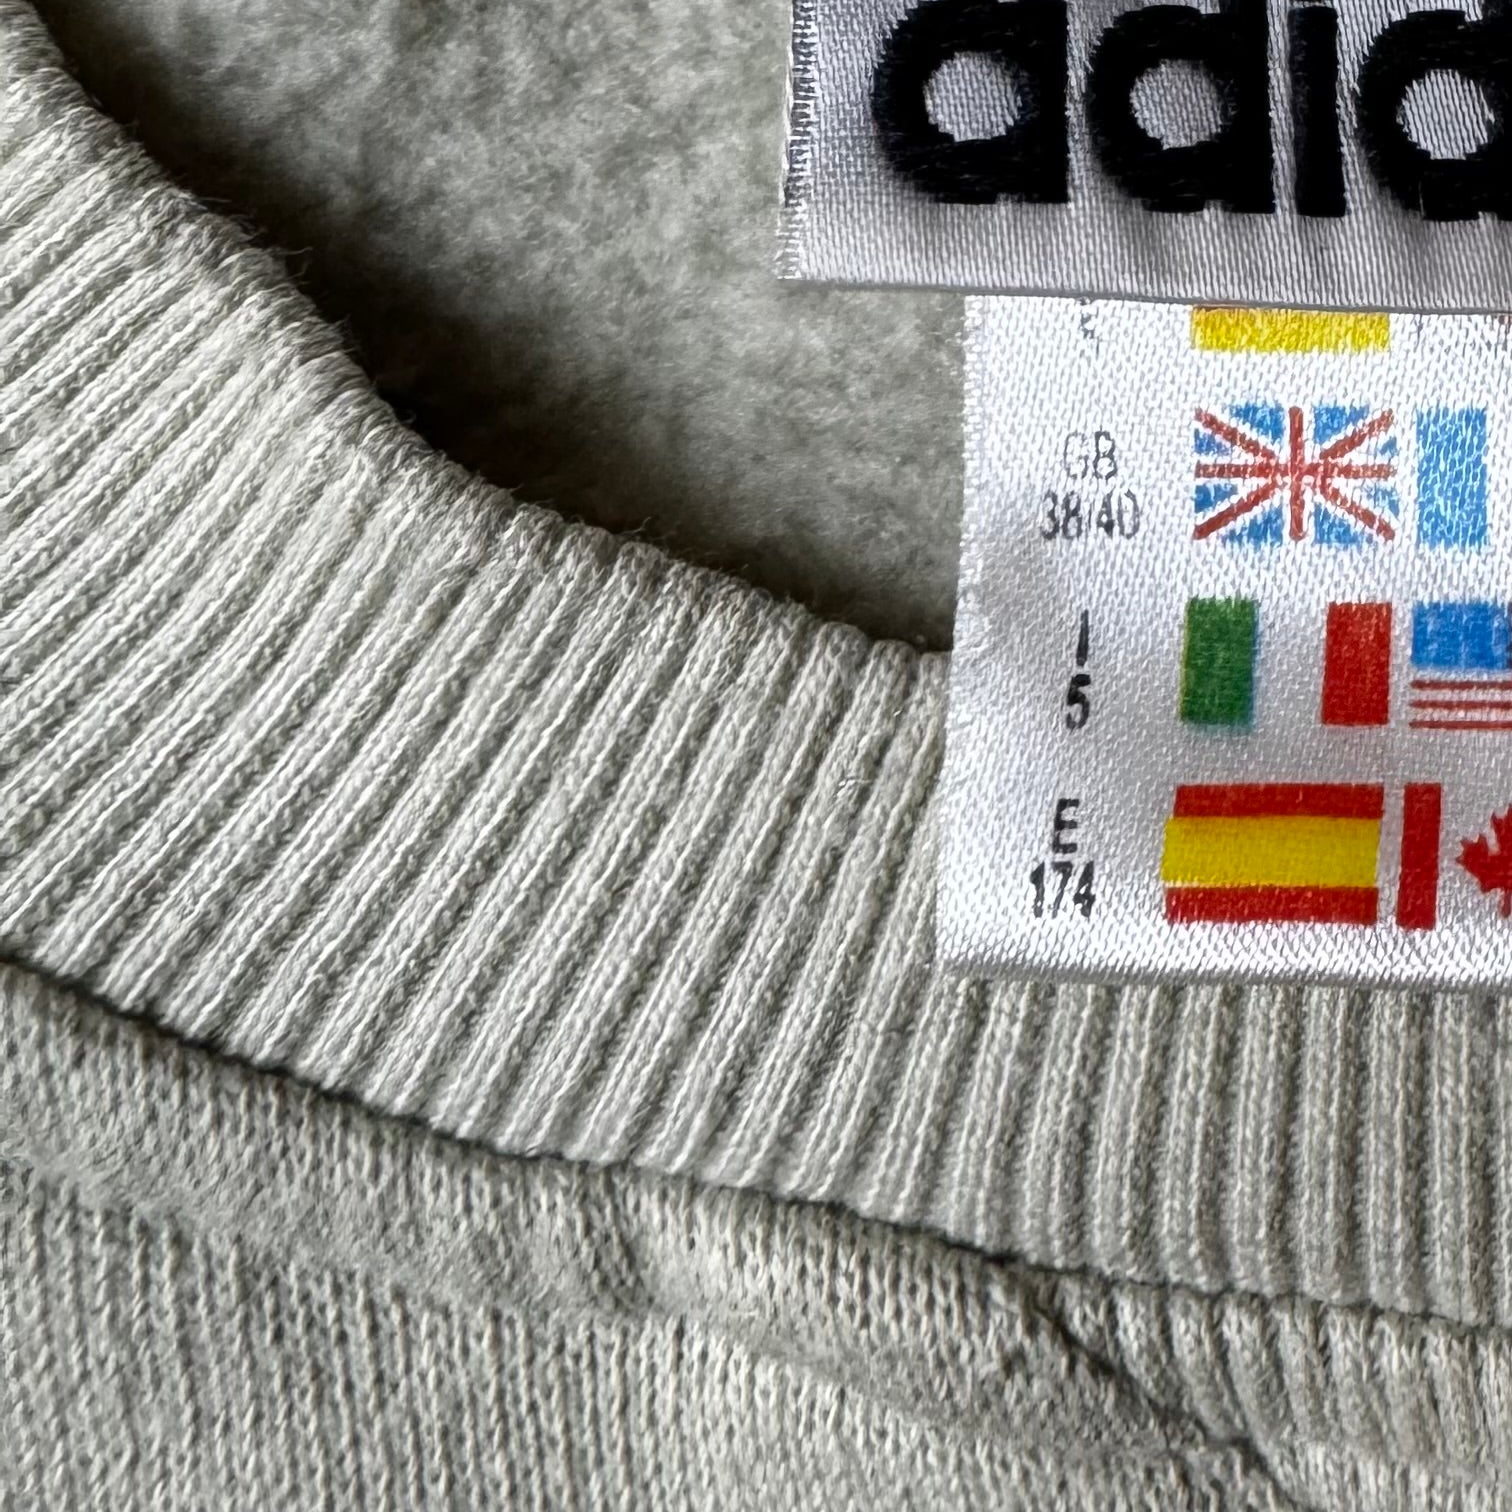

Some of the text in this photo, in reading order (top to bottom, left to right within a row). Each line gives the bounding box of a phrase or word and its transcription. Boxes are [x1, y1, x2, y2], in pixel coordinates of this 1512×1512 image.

[1063, 430, 1118, 480] GB
[1065, 673, 1092, 730] 5
[1051, 797, 1081, 855] E
[1030, 860, 1096, 918] 174
